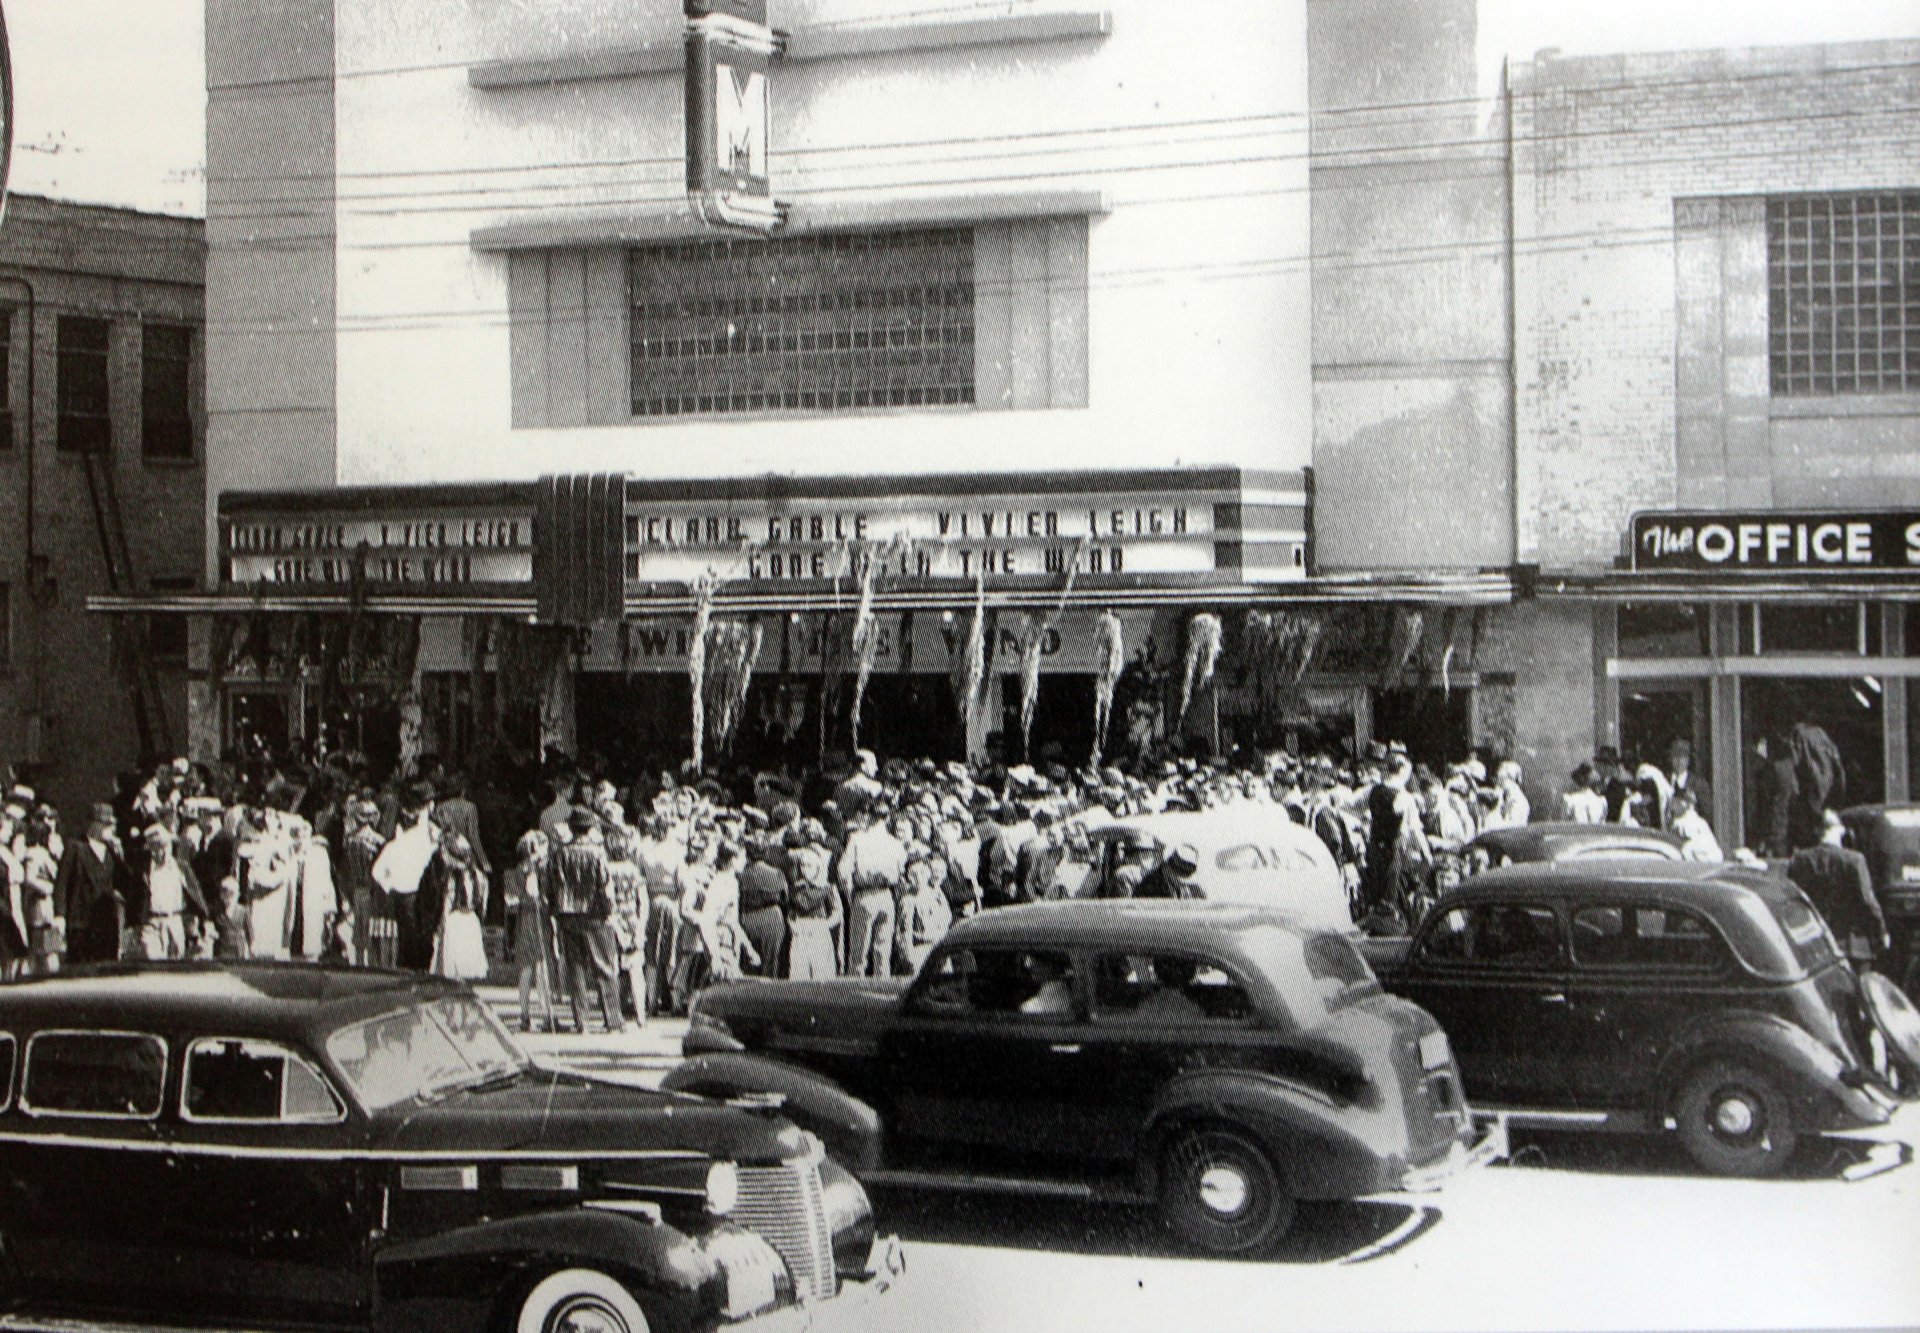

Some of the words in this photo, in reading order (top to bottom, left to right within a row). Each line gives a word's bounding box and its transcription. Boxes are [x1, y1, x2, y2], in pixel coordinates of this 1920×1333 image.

[715, 63, 767, 179] M
[647, 516, 746, 543] CLARK
[768, 513, 867, 541] GABLE
[937, 510, 1058, 537] VIVIEN
[1088, 507, 1188, 536] LEIGH
[1642, 525, 1694, 558] The
[1695, 522, 1874, 564] OFFICE
[748, 552, 825, 579] GONE
[959, 548, 1015, 577] THE
[1044, 546, 1124, 574] WND
